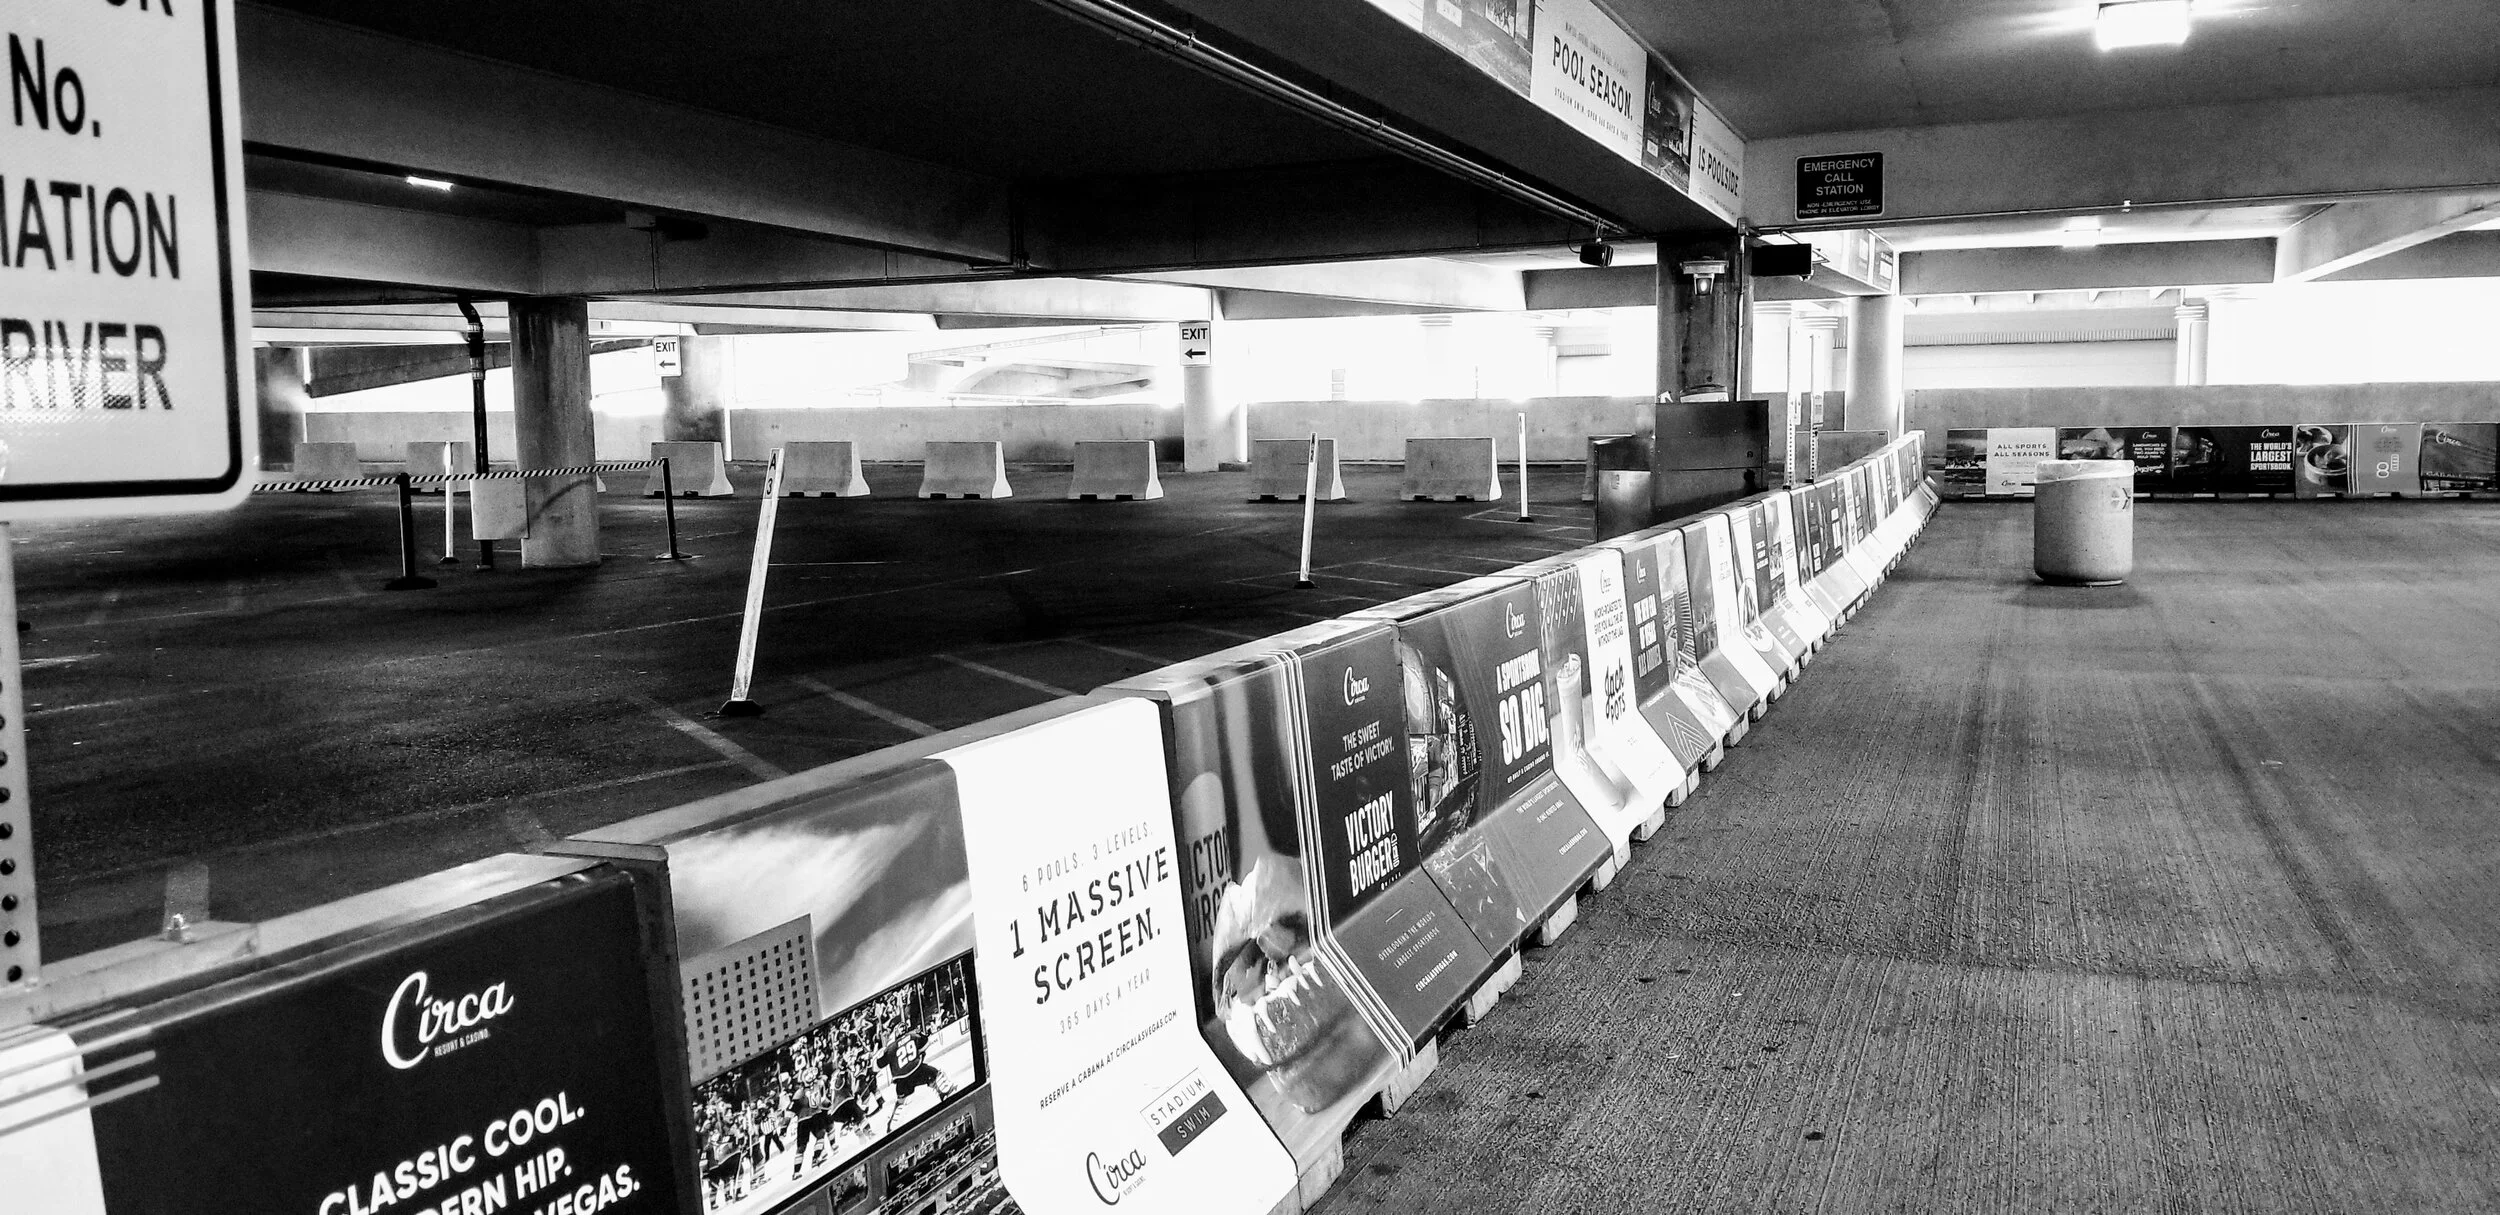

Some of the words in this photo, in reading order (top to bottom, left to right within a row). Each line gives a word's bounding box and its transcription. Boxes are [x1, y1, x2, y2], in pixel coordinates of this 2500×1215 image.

[9, 33, 102, 138] No.
[1553, 34, 1585, 87] POOL
[1589, 64, 1633, 121] SEASON.
[1698, 145, 1706, 172] IS
[1804, 158, 1875, 172] EMERGENCY
[1824, 172, 1854, 183] CALL
[1816, 184, 1864, 196] STATION
[655, 341, 676, 353] EXIT
[1181, 328, 1208, 340] EXIT
[769, 453, 777, 470] A
[2250, 442, 2262, 450] THE
[2263, 442, 2292, 450] WORLD'S
[2250, 450, 2292, 462] LARGEST
[2250, 462, 2293, 470] SPORTSBOOK.
[766, 478, 773, 495] 3
[1344, 666, 1369, 706] Circa
[1496, 665, 1503, 694] A
[1342, 730, 1358, 753] THE
[1357, 720, 1380, 746] SWEET
[1499, 694, 1523, 766] SO
[1521, 681, 1550, 752] BIG.
[1331, 756, 1354, 781] TASTE
[1353, 750, 1364, 770] OF
[1364, 735, 1395, 764] VICTORY.
[1344, 790, 1394, 855] VICTORY
[1022, 874, 1028, 893] 6
[1038, 852, 1084, 886] POOLS.
[1092, 843, 1098, 860] 3
[1107, 821, 1153, 855] LEVELS.
[1349, 836, 1394, 898] BURGER
[1010, 918, 1025, 959] 1
[1037, 846, 1169, 943] MASSIVE
[1409, 925, 1418, 936] THE
[1034, 907, 1161, 1005] SCREEN.
[381, 971, 514, 1069] Circa
[1060, 1011, 1080, 1034] 365
[1086, 992, 1112, 1019] DAYS
[1117, 985, 1122, 999] A
[1127, 967, 1151, 993] YEAR
[896, 1040, 917, 1069] 29
[1040, 1082, 1070, 1110] RESERVE
[1071, 1078, 1077, 1088] A
[1078, 1058, 1105, 1083] CABANA
[1106, 1051, 1115, 1065] AT
[1115, 1010, 1177, 1058] CIRCALASVEGAS.COM
[1150, 1078, 1206, 1126] STADIUM
[1176, 1106, 1211, 1139] SWIM
[318, 1135, 476, 1215] CLASSIC
[484, 1091, 585, 1157] COOL.
[514, 1147, 572, 1200] HIP.
[1086, 1148, 1147, 1206] Circa
